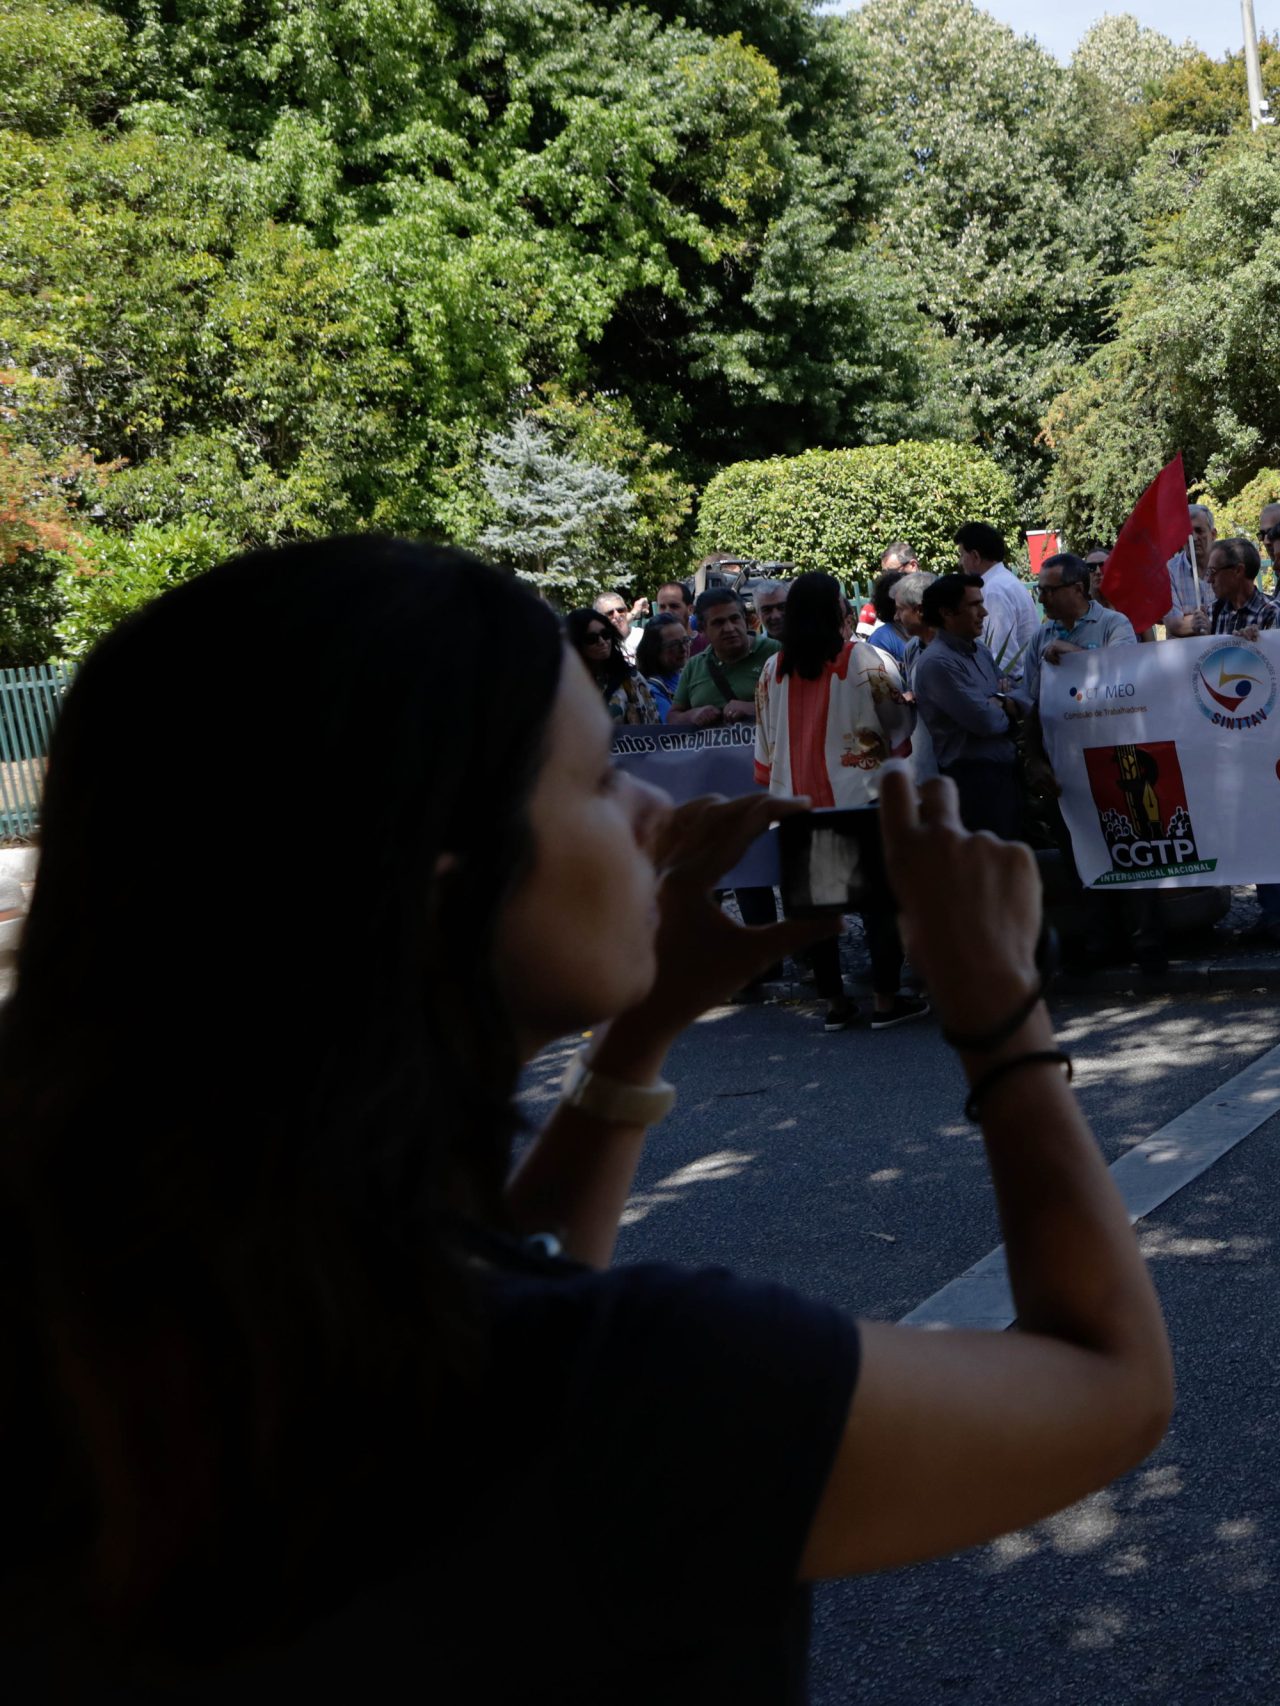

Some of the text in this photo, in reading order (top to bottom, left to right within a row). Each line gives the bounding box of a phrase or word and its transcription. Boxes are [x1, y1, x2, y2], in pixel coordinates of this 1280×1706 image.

[1105, 683, 1135, 699] MEO
[1211, 708, 1267, 730] SINTTAV
[1111, 838, 1195, 868] CGTP
[1101, 863, 1211, 882] INTERSINDICAL NACIONAL
